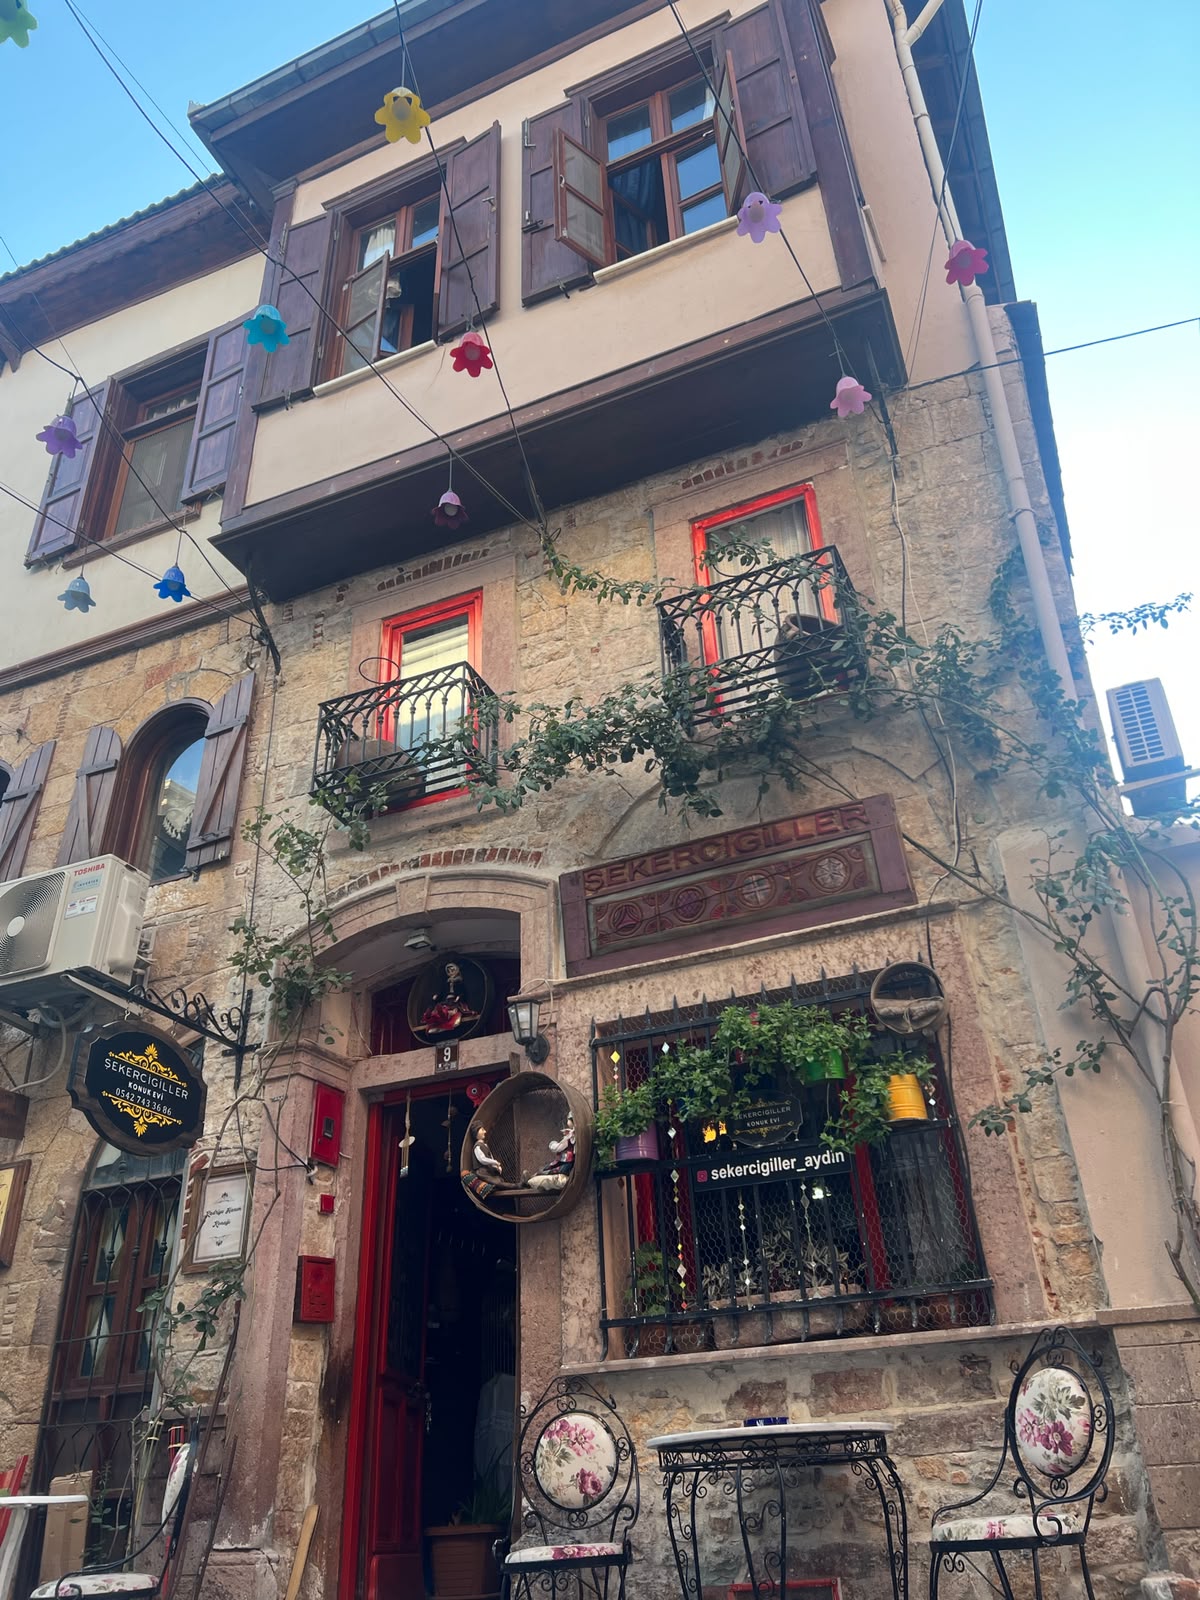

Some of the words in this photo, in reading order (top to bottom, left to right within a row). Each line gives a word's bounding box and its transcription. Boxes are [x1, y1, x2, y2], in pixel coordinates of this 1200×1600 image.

[74, 863, 106, 877] TOSHIBA
[443, 1046, 451, 1062] 9
[104, 1058, 189, 1100] ŞEKERCİGİLLER
[128, 1081, 152, 1096] KONUK
[152, 1091, 164, 1101] EVİ
[115, 1087, 135, 1102] 0542
[136, 1095, 151, 1108] 743
[151, 1101, 161, 1112] 36
[162, 1105, 172, 1116] 86
